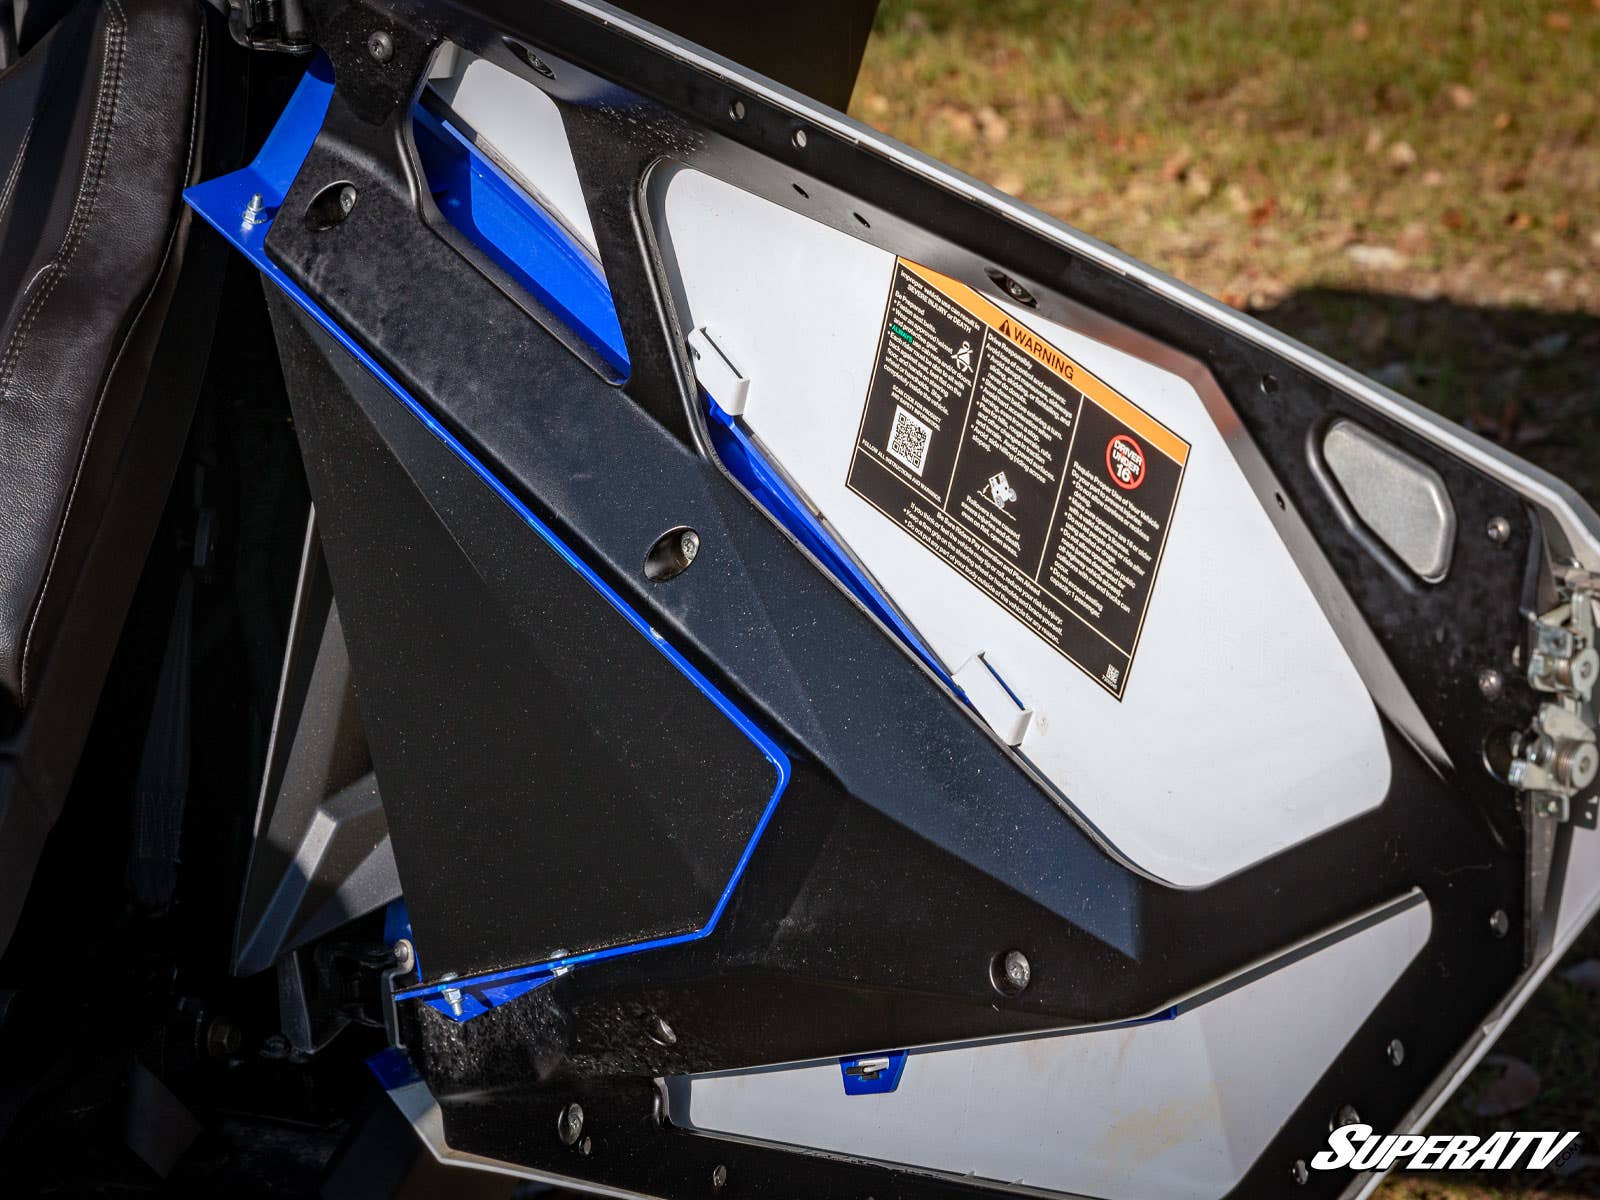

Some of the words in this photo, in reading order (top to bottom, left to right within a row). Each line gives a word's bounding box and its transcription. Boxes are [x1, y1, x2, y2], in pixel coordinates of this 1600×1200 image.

[908, 284, 928, 303] SEVERE
[927, 298, 948, 317] INJURY
[953, 317, 971, 334] DEATH
[1016, 327, 1074, 380] WARNING
[1112, 450, 1141, 476] UNDER
[1114, 440, 1143, 467] DRIVER
[1114, 462, 1132, 484] 16
[1073, 461, 1094, 481] Require
[1093, 475, 1112, 495] Proper
[1112, 490, 1122, 501] Use
[1128, 501, 1141, 516] Your
[1141, 510, 1159, 529] Vehicle
